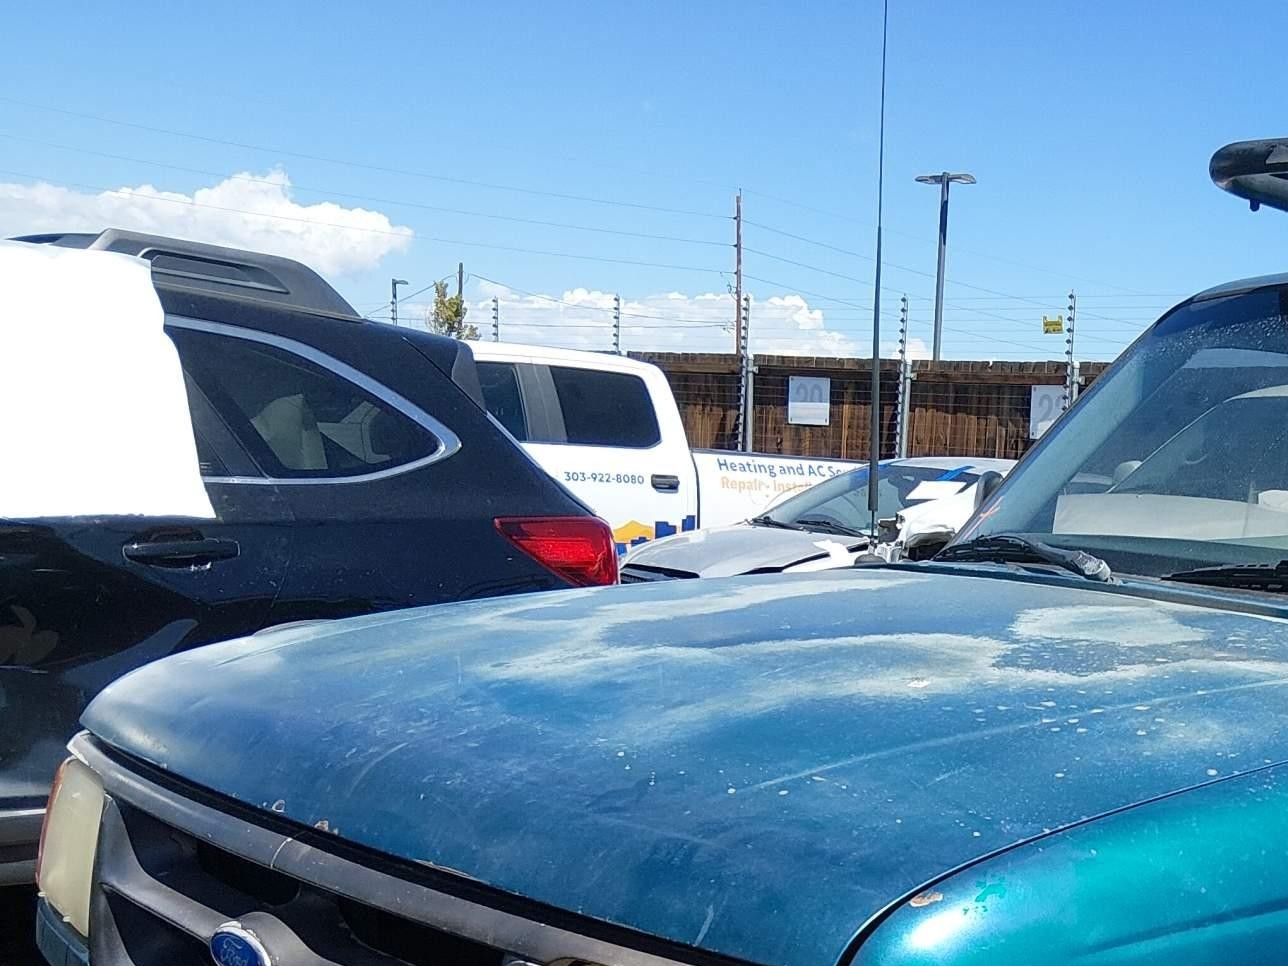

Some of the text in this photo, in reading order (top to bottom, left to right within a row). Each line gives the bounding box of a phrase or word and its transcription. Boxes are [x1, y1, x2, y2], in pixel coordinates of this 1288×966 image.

[716, 457, 775, 478] Heating
[779, 462, 805, 476] and
[808, 464, 826, 477] AC
[564, 471, 645, 485] 303-922-8080
[720, 475, 762, 493] Repair
